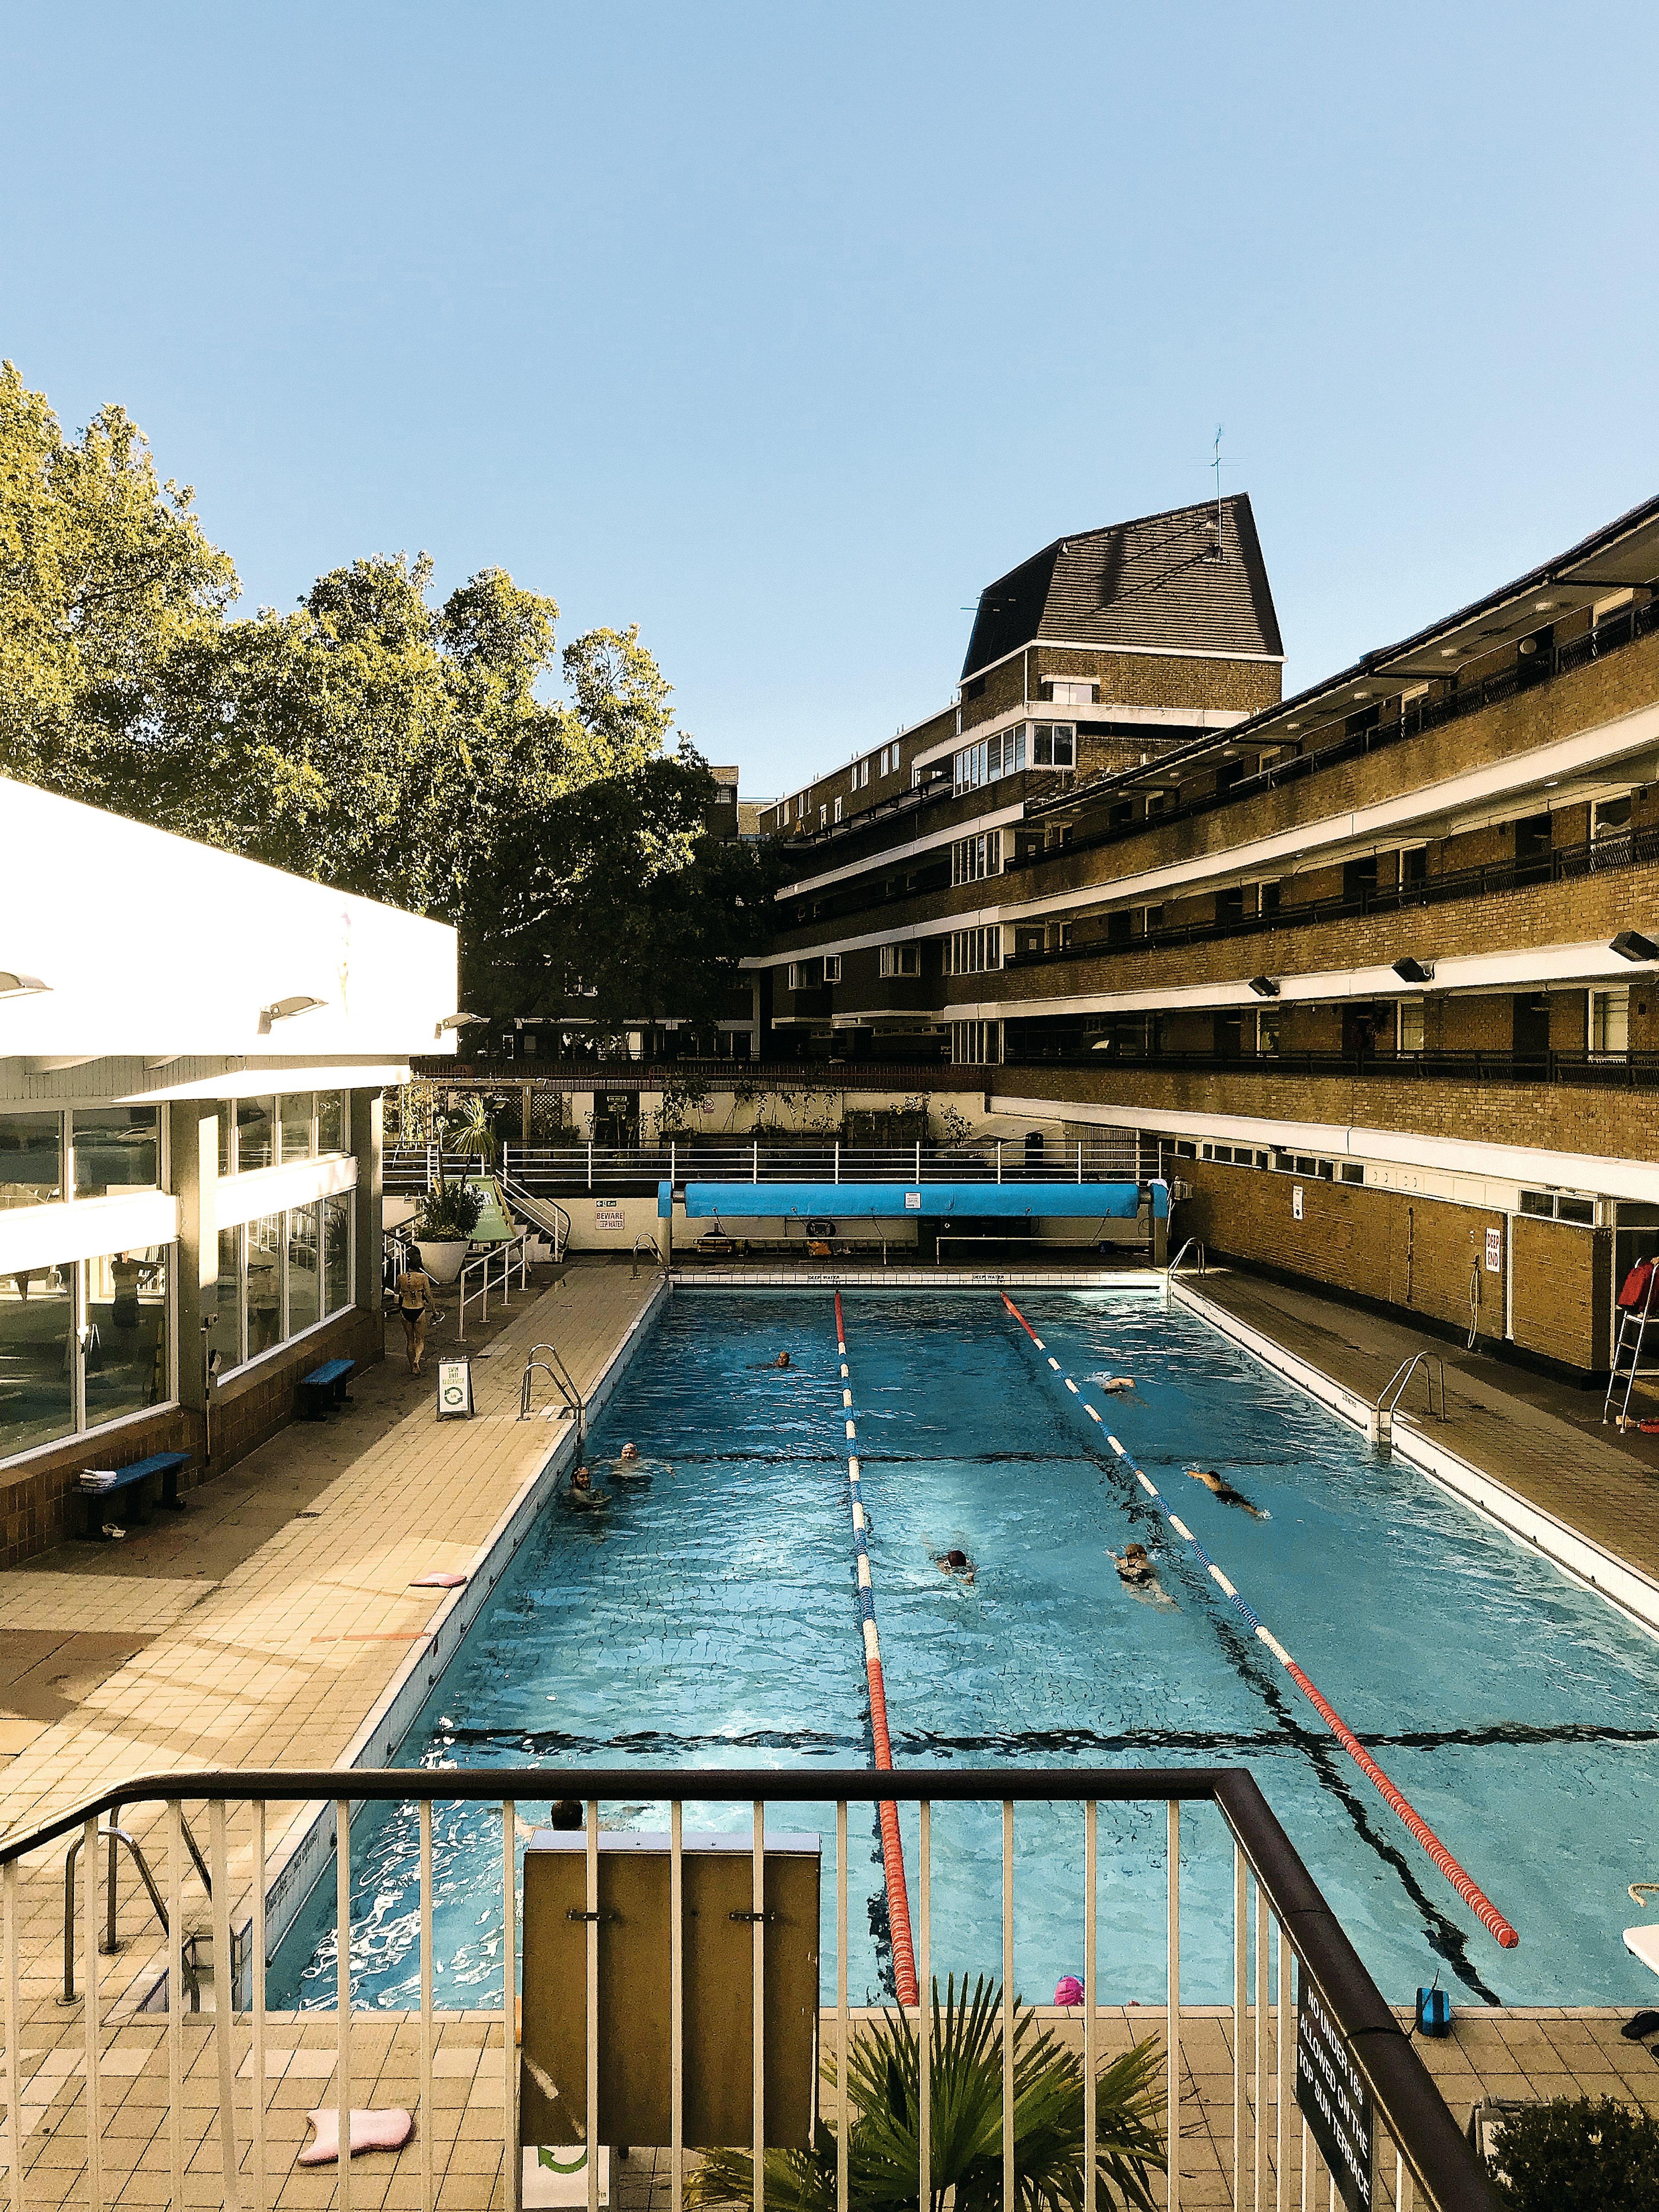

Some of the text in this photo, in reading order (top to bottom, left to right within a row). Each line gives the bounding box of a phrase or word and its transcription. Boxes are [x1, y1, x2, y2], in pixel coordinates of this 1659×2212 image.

[1487, 1233, 1499, 1249] DEEP
[1488, 1251, 1498, 1267] END
[1300, 2013, 1368, 2159] ALLOWED ON THE
[1308, 1986, 1363, 2106] NO UNDER 16s
[1299, 2045, 1370, 2206] TOP SUN TERRACE
